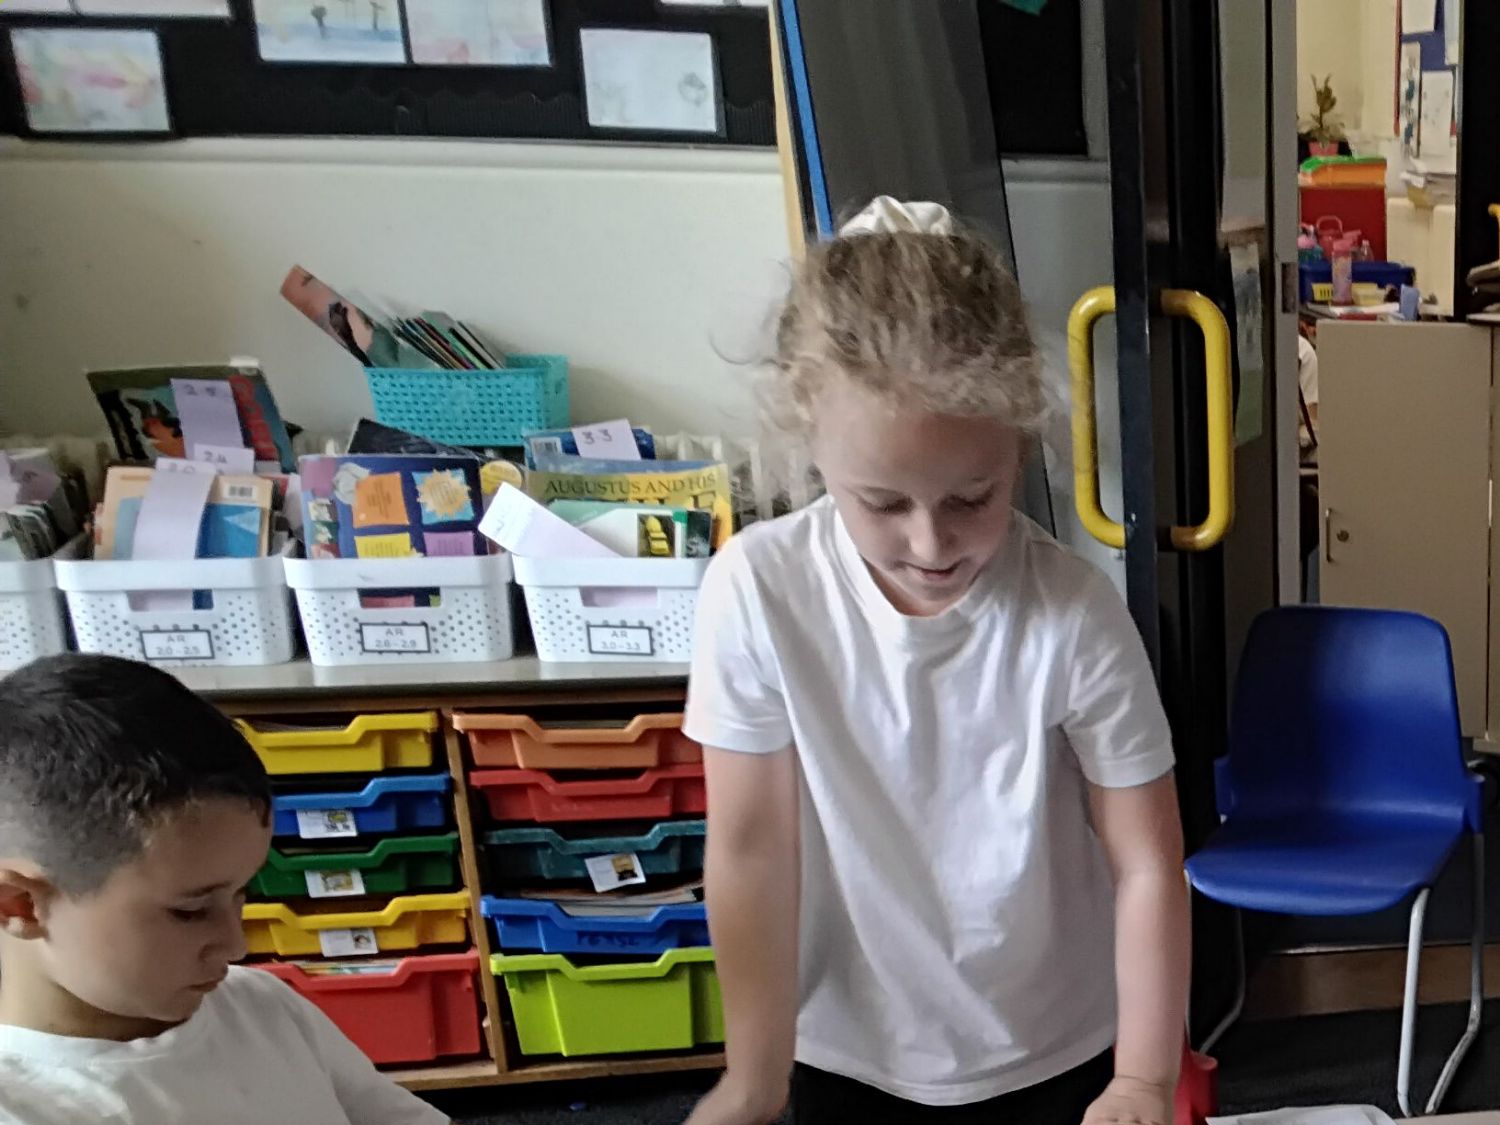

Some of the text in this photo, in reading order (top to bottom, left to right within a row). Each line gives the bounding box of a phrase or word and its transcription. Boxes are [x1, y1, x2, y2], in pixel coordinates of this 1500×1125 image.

[545, 472, 716, 495] AUGUSTUS AND HIS
[385, 628, 405, 636] AR
[611, 630, 628, 638] AR
[167, 635, 185, 643] AR
